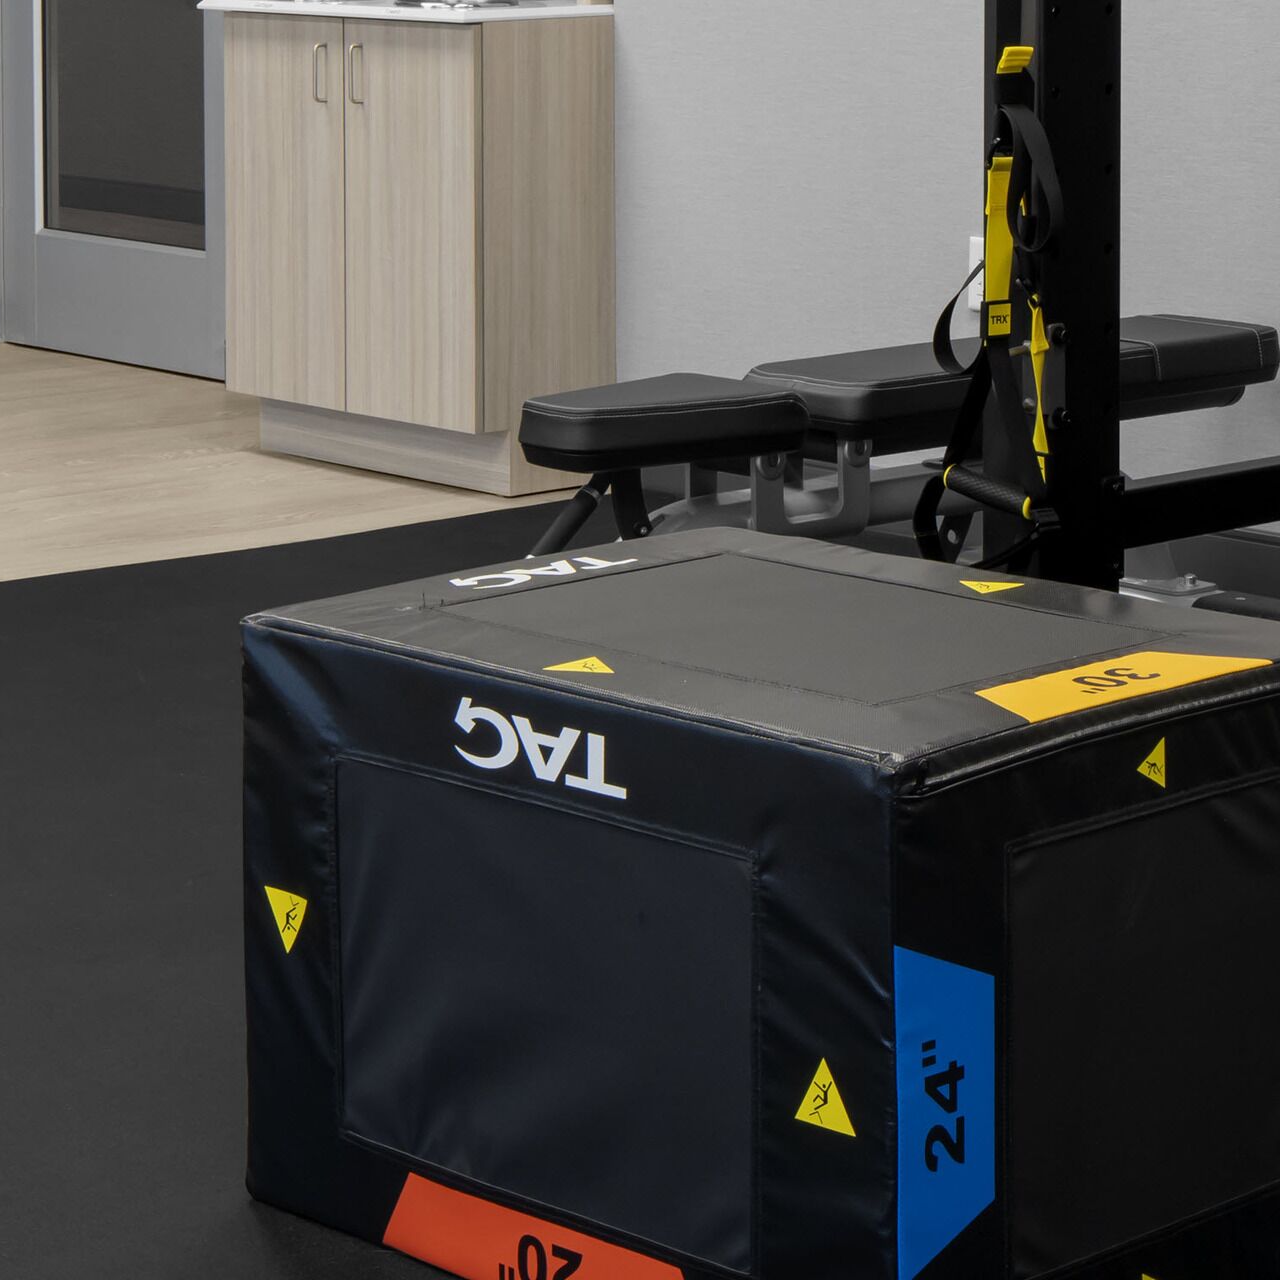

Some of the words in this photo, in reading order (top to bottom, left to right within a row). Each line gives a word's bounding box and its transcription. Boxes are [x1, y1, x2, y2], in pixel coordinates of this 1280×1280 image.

[990, 315, 1009, 325] TRX
[449, 556, 639, 590] TAG
[1071, 667, 1162, 695] 30"
[454, 696, 627, 800] TAG
[922, 1039, 965, 1173] 24"
